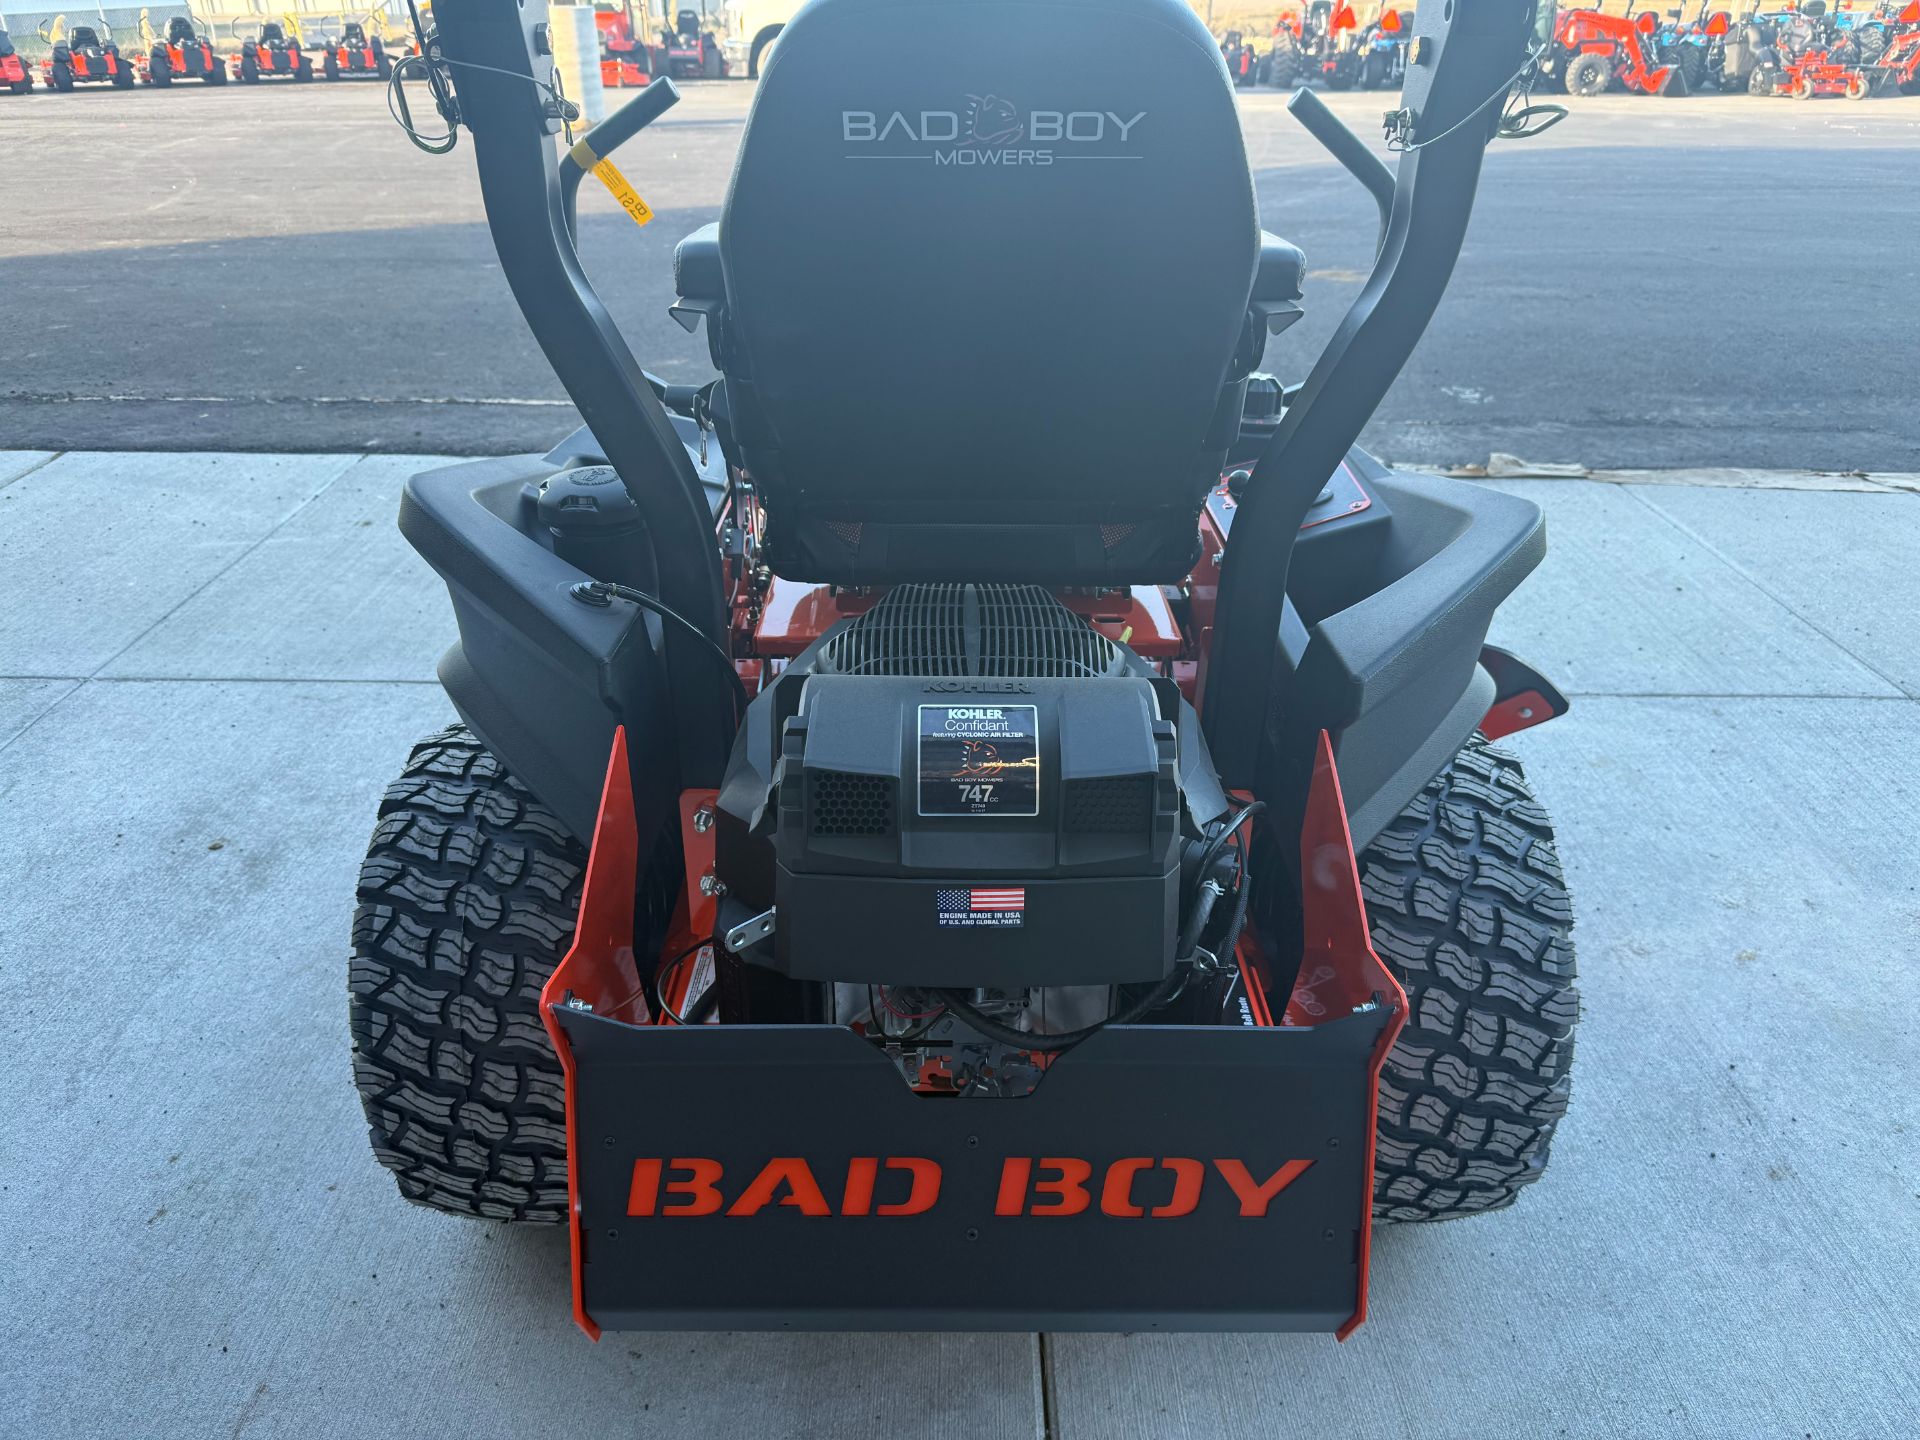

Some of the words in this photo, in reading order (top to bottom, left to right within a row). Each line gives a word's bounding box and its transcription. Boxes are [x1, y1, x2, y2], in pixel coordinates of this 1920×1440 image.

[842, 111, 958, 141] BAD
[1029, 111, 1147, 141] BOY
[935, 149, 1053, 165] MOWERS
[944, 720, 1009, 731] Confidant
[1004, 911, 1021, 919] USA
[626, 1157, 943, 1217] BAD
[994, 1157, 1318, 1218] BOY
